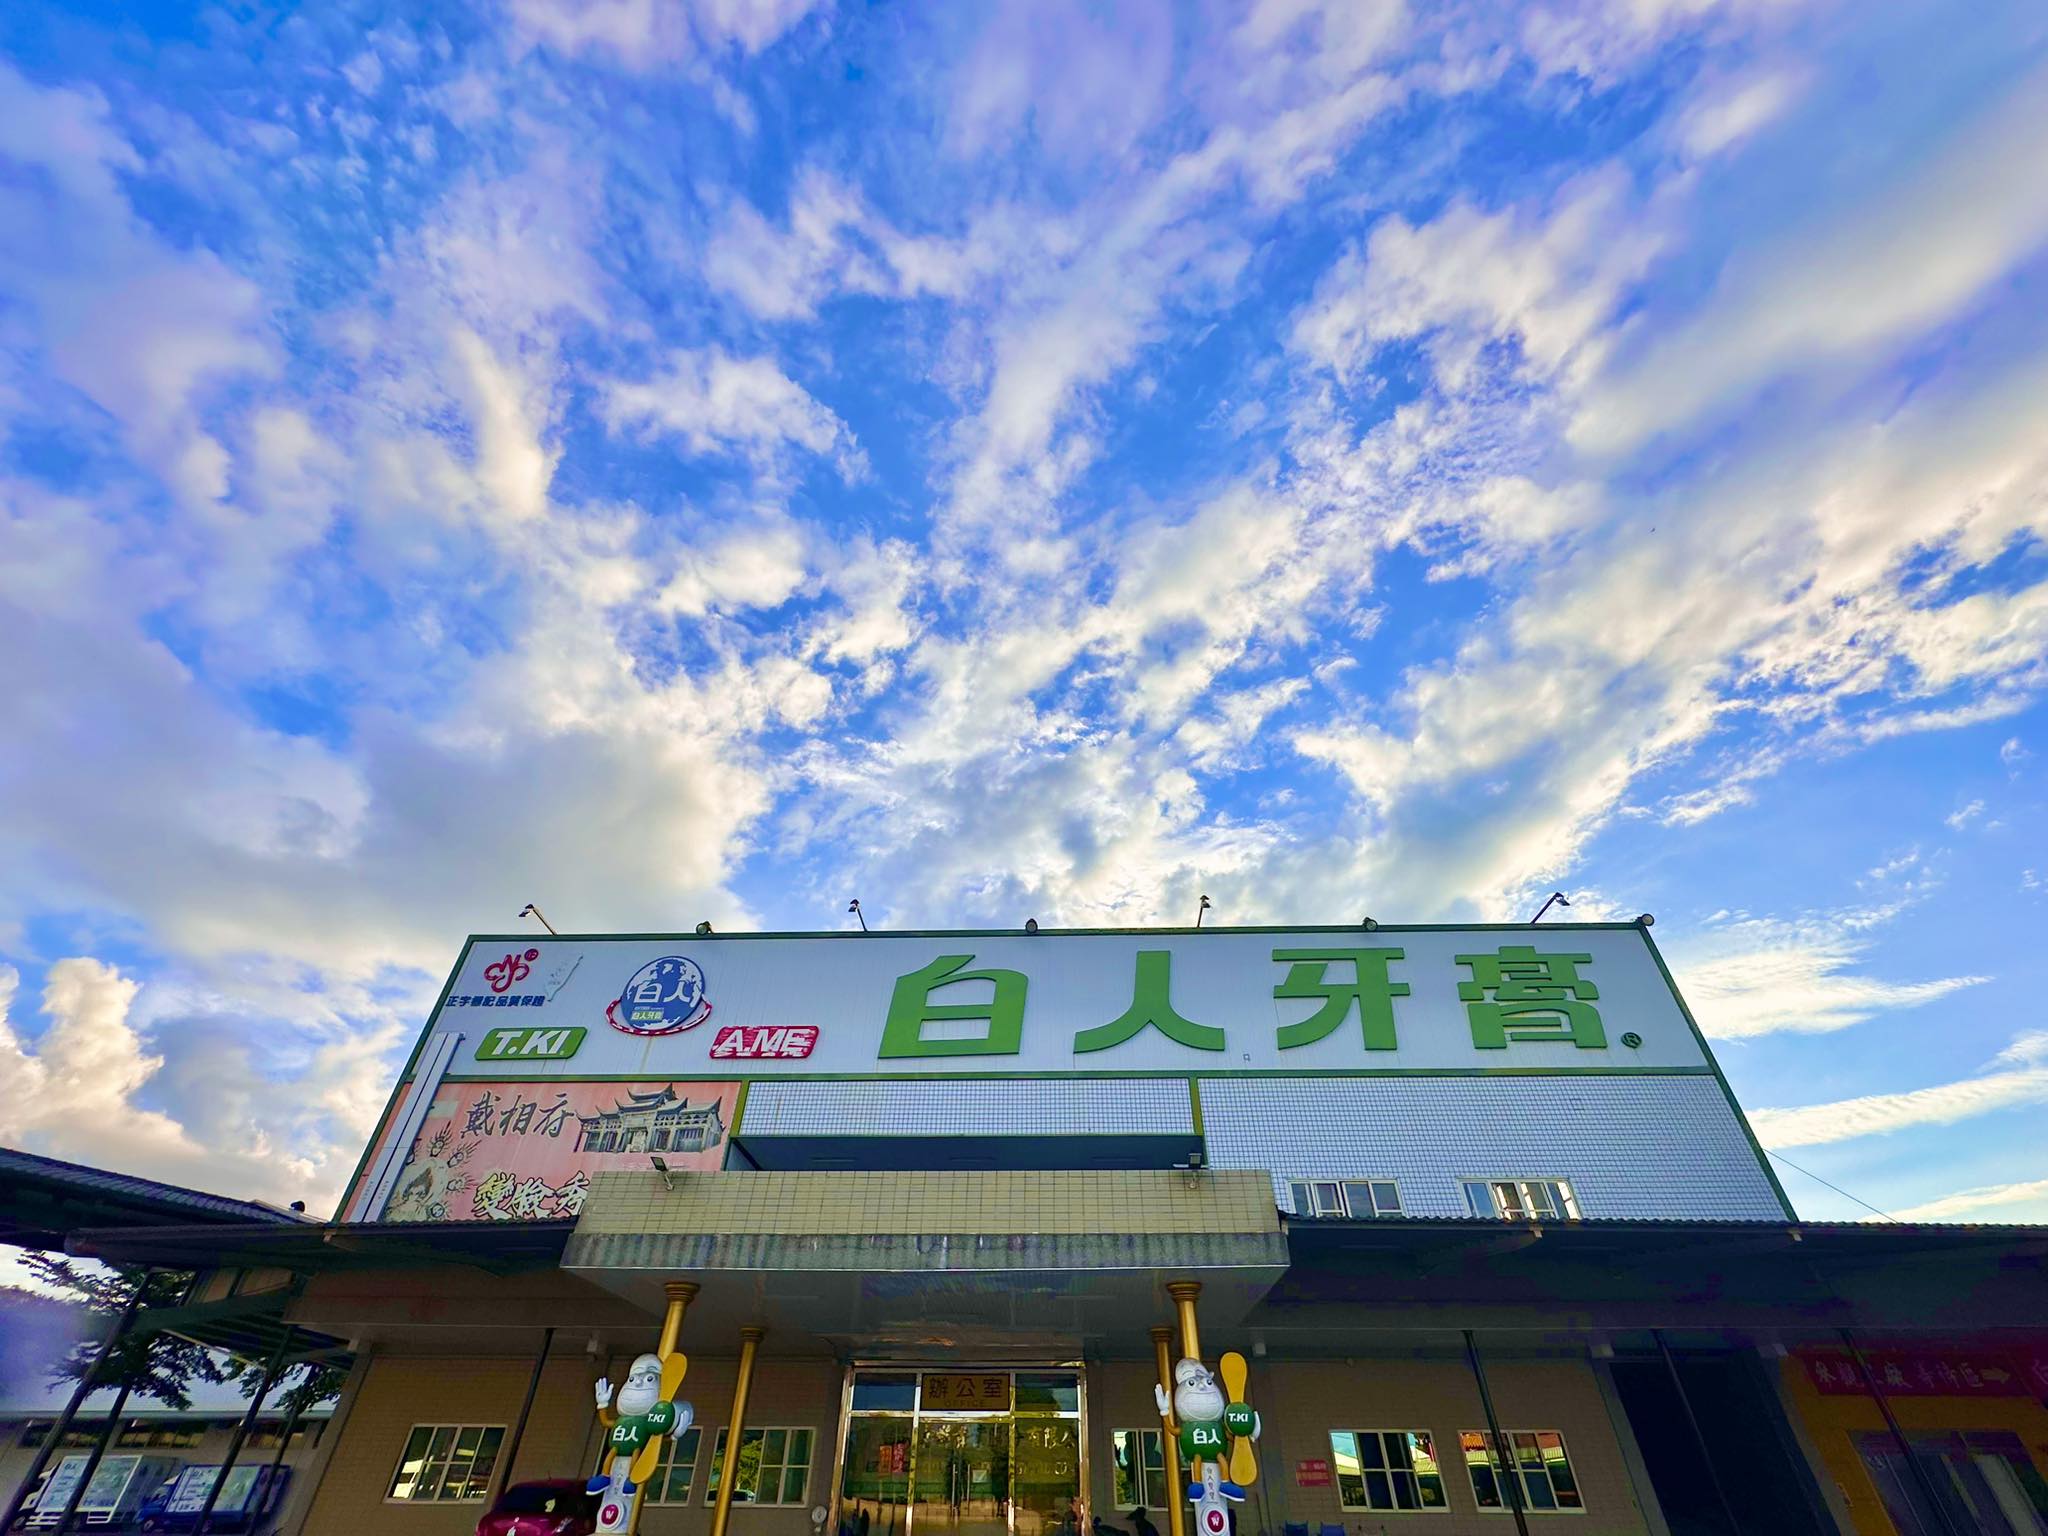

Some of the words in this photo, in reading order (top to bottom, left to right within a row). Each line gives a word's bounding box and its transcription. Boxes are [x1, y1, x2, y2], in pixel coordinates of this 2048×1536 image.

[633, 980, 692, 1004] 白人
[877, 945, 1608, 1059] 白人牙膏
[491, 1029, 571, 1055] T.KI
[460, 1090, 575, 1139] 戴相府
[928, 1377, 1002, 1399] 辦公室
[648, 1413, 666, 1423] T.KI
[1228, 1412, 1249, 1423] T.KI
[613, 1425, 639, 1442] 白人
[1192, 1428, 1222, 1445] 白人
